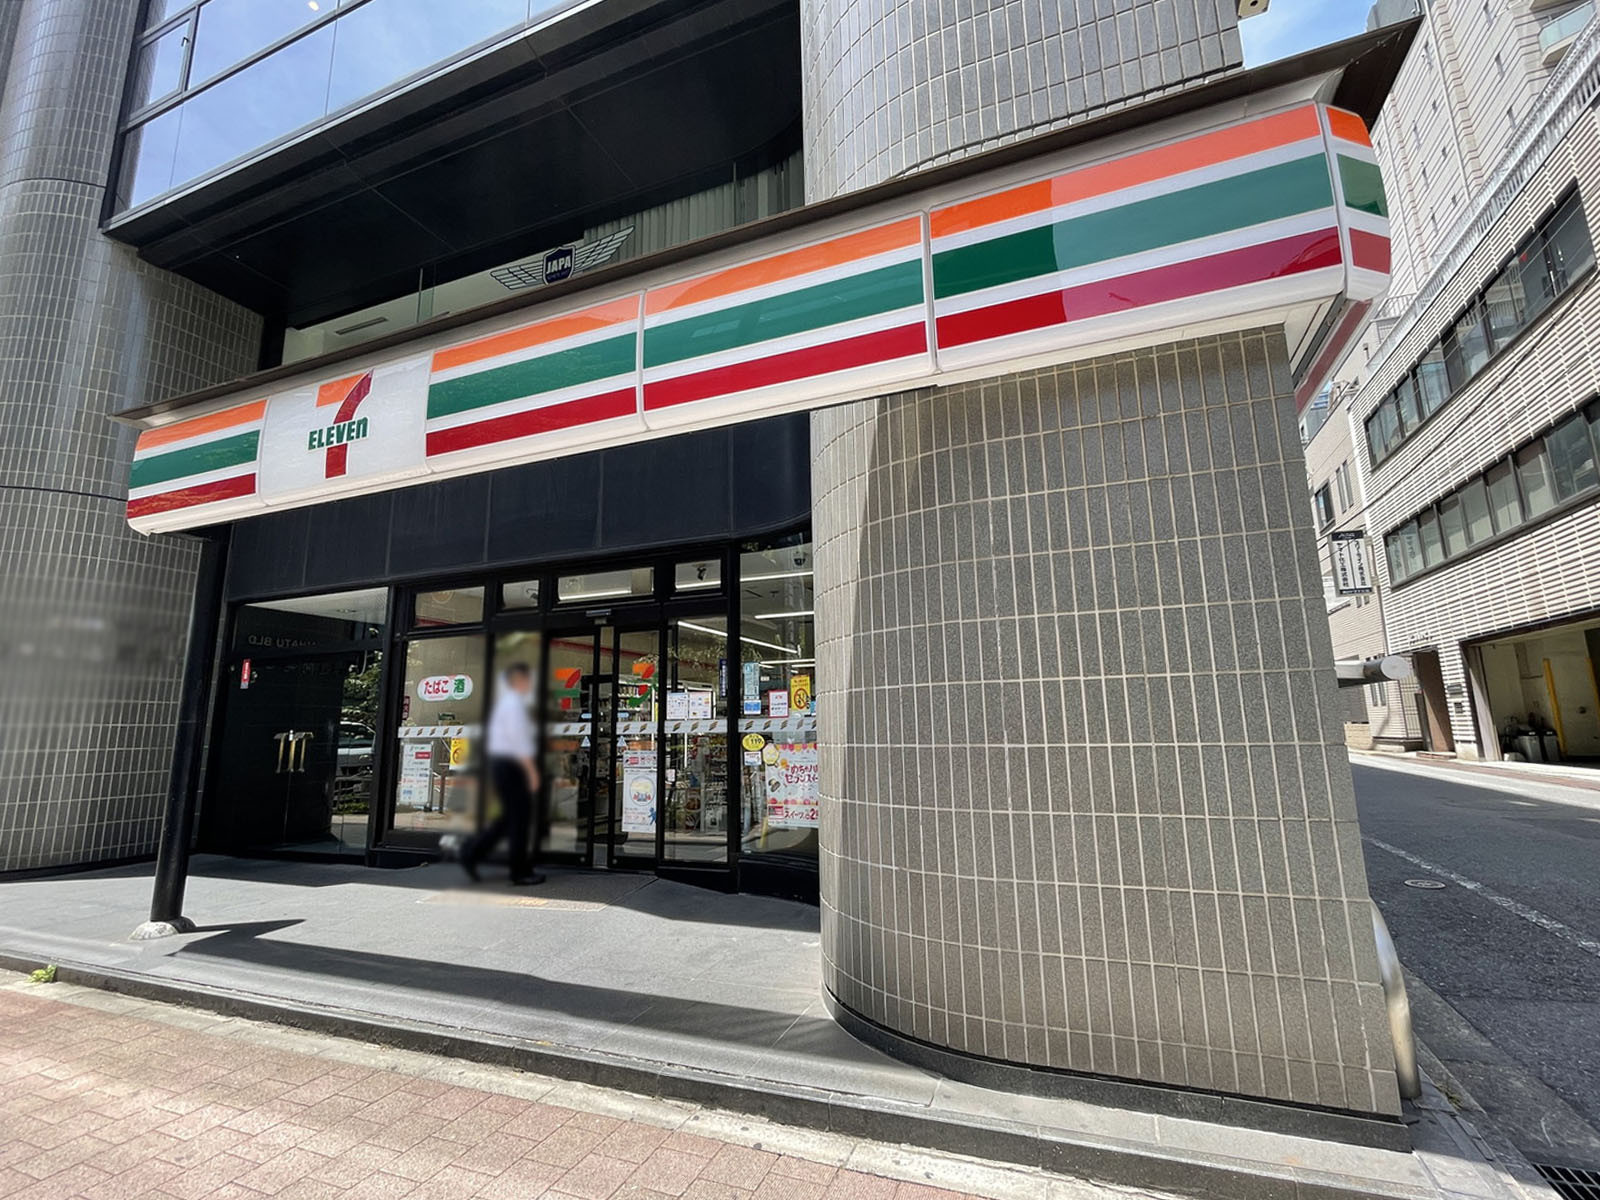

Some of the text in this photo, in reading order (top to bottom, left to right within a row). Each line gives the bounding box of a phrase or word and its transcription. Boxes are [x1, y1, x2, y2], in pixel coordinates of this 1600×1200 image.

[546, 256, 571, 274] JAPA
[424, 679, 465, 694] たばこ 酒
